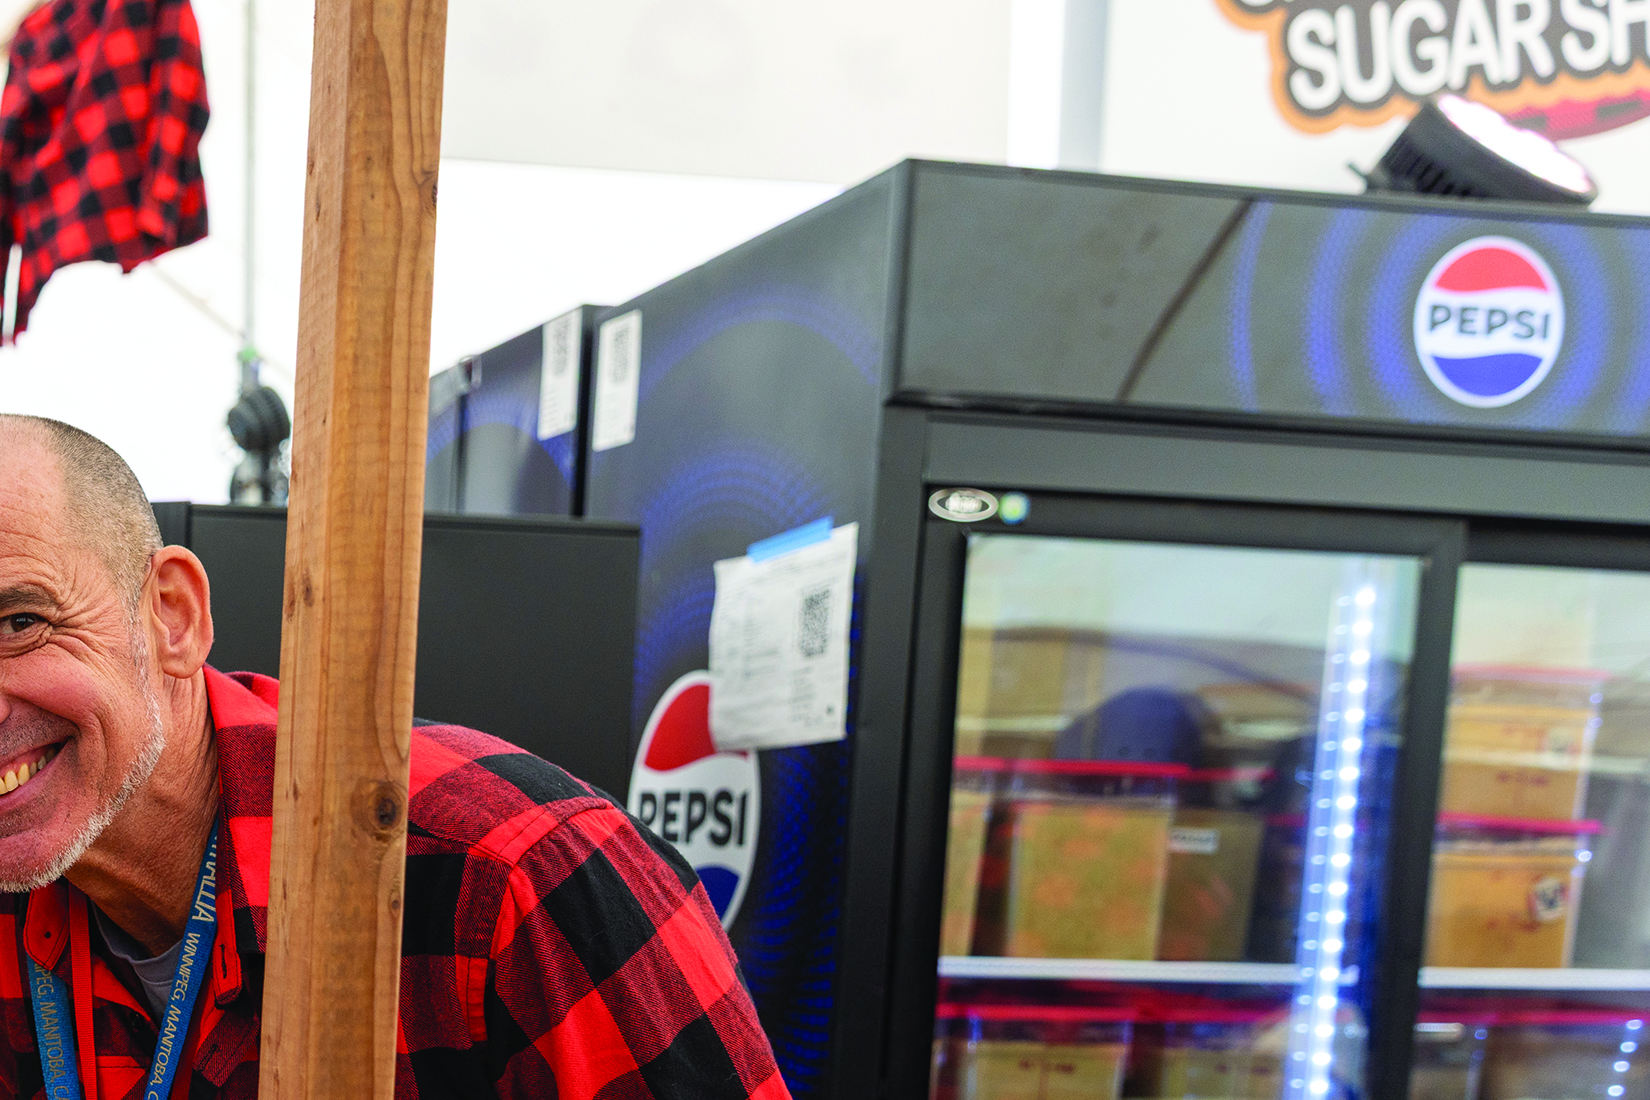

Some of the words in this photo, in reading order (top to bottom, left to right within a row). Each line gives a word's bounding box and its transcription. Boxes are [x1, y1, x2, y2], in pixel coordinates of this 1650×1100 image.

[1288, 0, 1554, 109] SUGAR
[1429, 304, 1549, 340] PEPSI
[639, 791, 747, 846] PEPSI
[170, 932, 200, 1001] WINNIPEG,
[150, 1004, 181, 1085] MANITOBA,
